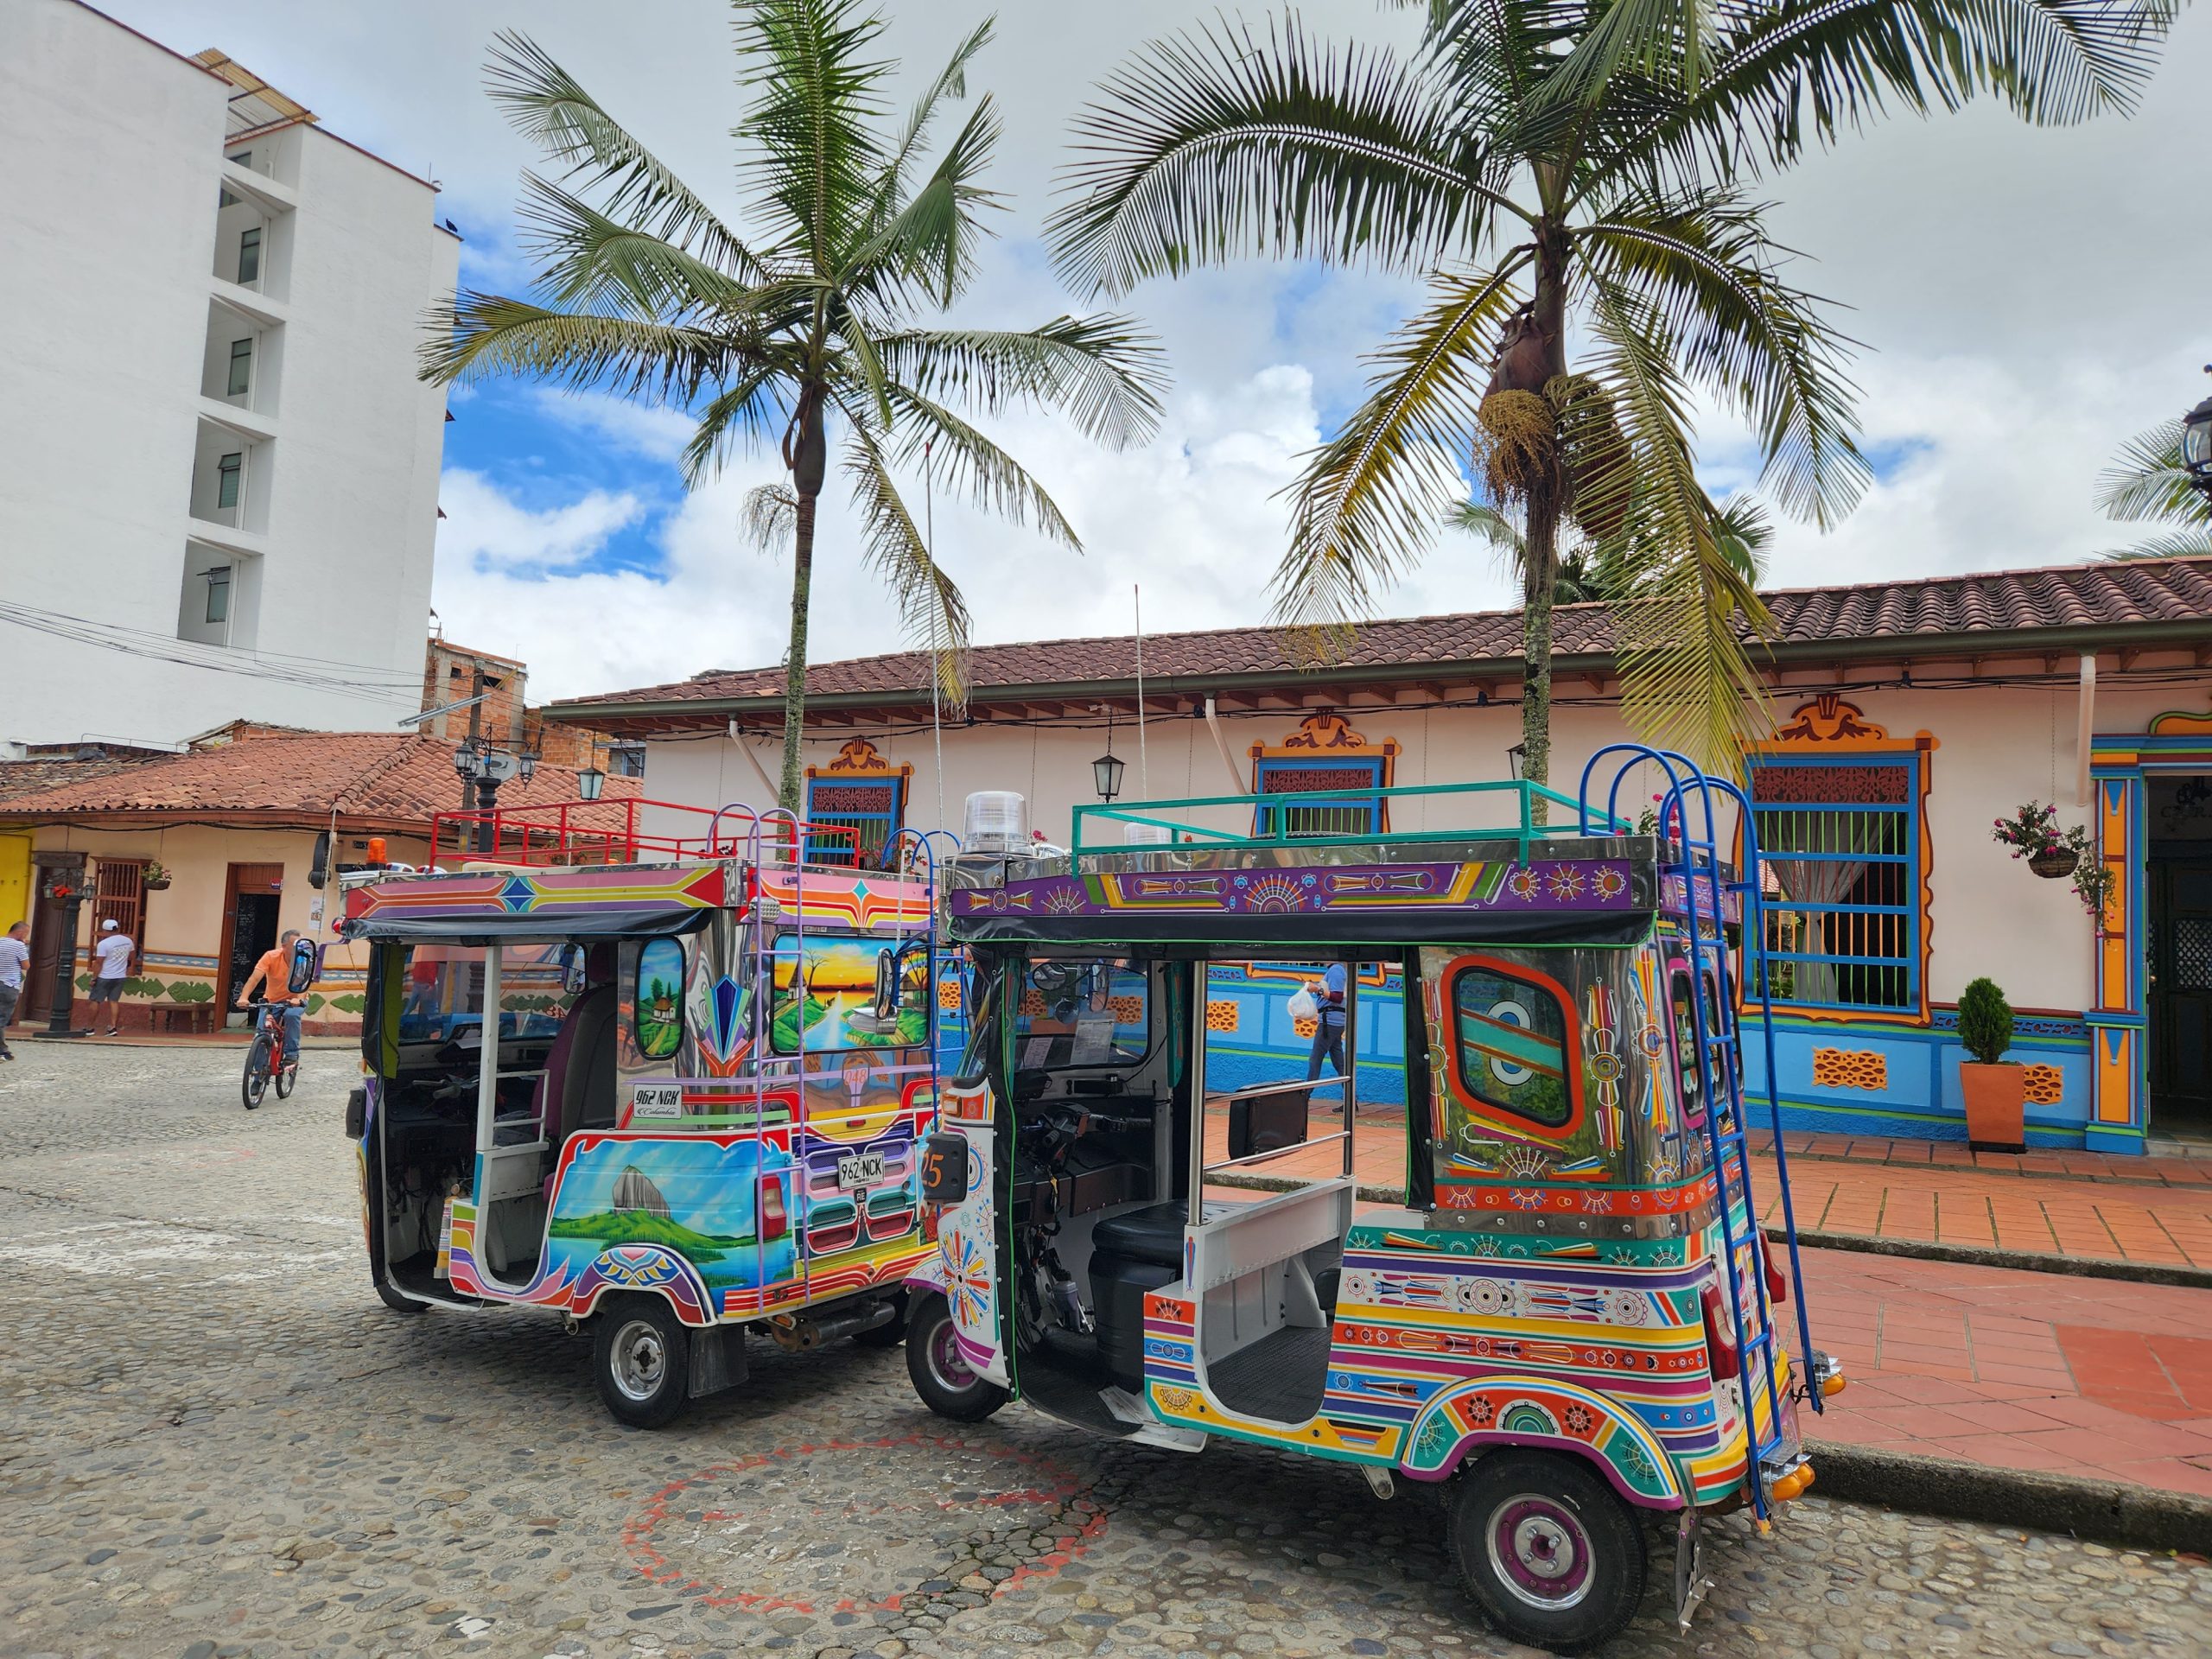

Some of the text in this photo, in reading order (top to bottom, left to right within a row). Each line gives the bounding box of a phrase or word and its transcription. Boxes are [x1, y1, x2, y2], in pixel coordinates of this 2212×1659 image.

[843, 1069, 868, 1086] 048
[635, 1090, 680, 1105] 962 NCK
[841, 1158, 882, 1182] 962 NCK
[856, 1192, 866, 1201] RE
